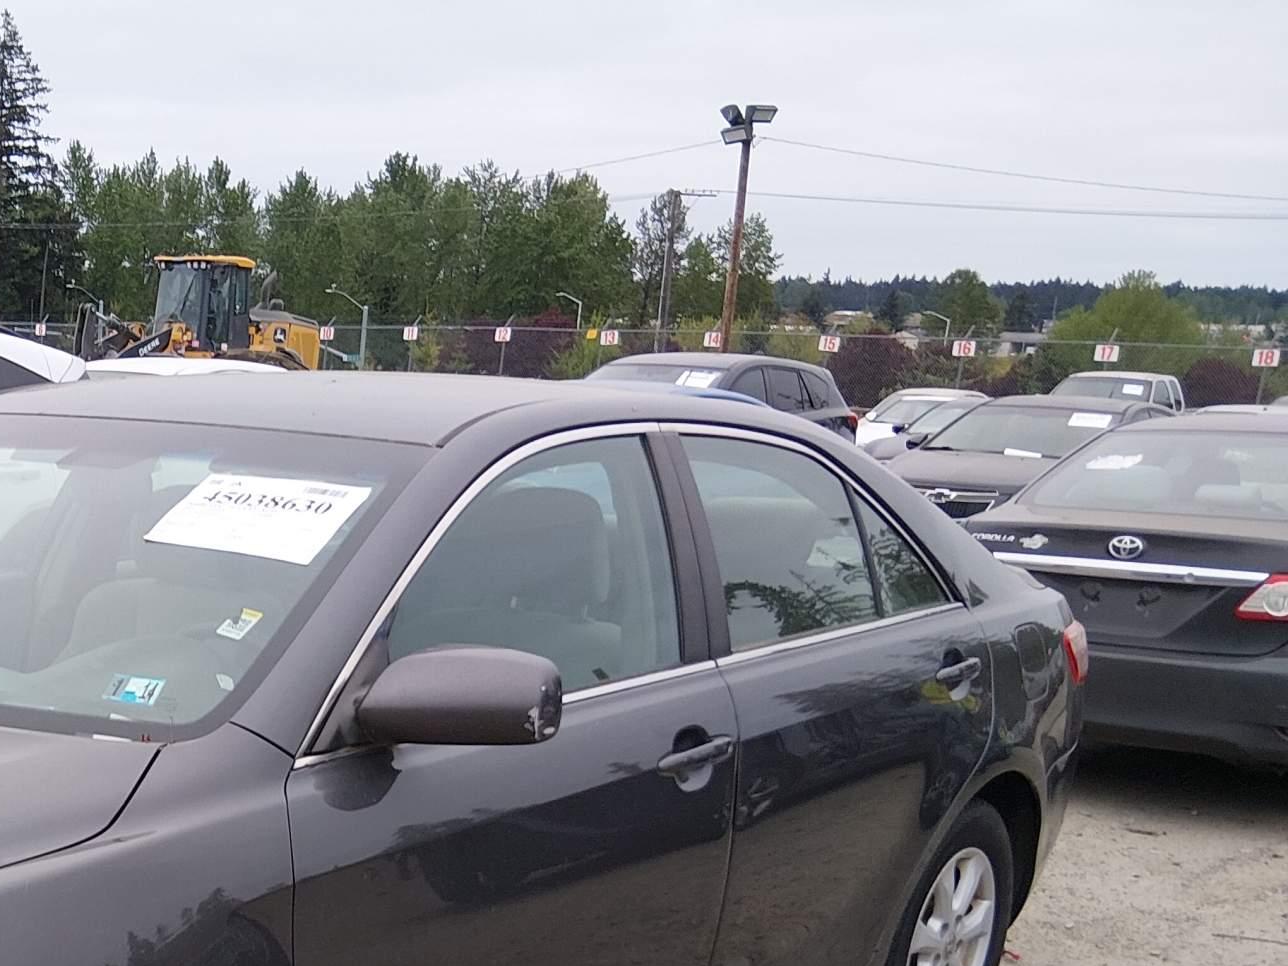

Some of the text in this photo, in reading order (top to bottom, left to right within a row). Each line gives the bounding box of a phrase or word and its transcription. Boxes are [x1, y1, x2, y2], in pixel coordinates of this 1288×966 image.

[322, 327, 332, 339] 10
[407, 327, 415, 339] 11
[498, 328, 508, 341] 12
[603, 331, 616, 344] 13
[707, 333, 719, 346] 14
[138, 337, 160, 357] DEERE
[822, 336, 836, 350] 15
[957, 341, 971, 355] 16
[1099, 346, 1114, 360] 17
[1257, 350, 1274, 365] 18
[202, 489, 334, 515] 45038630
